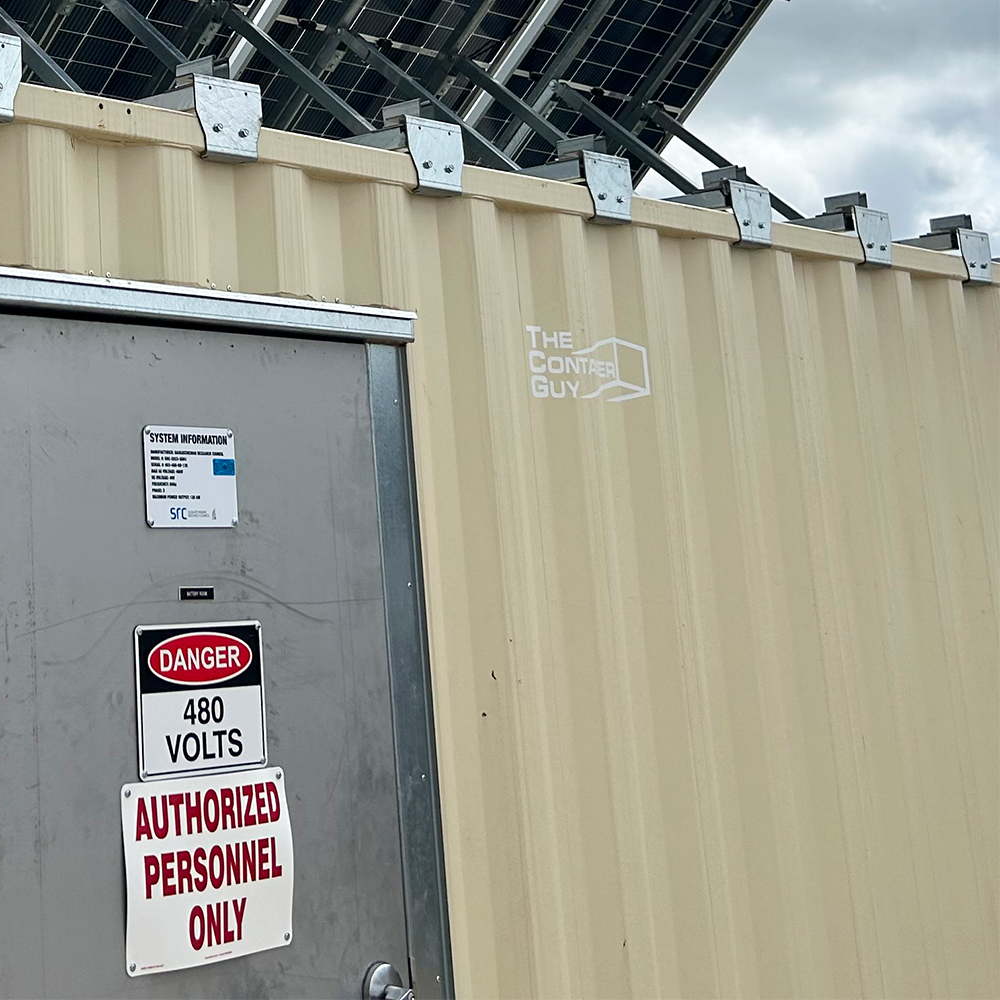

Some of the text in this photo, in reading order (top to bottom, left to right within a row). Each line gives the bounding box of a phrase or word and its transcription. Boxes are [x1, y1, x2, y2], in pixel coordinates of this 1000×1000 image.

[525, 325, 573, 350] THE
[530, 375, 580, 399] GUY
[149, 432, 228, 446] SYSTEM INFORMATION
[159, 645, 242, 673] DANGER
[183, 695, 225, 726] 480
[165, 727, 244, 764] VOLTS
[135, 781, 281, 842] AUTHORIZED
[143, 836, 283, 900] PERSONNEL
[188, 896, 248, 952] ONLY
